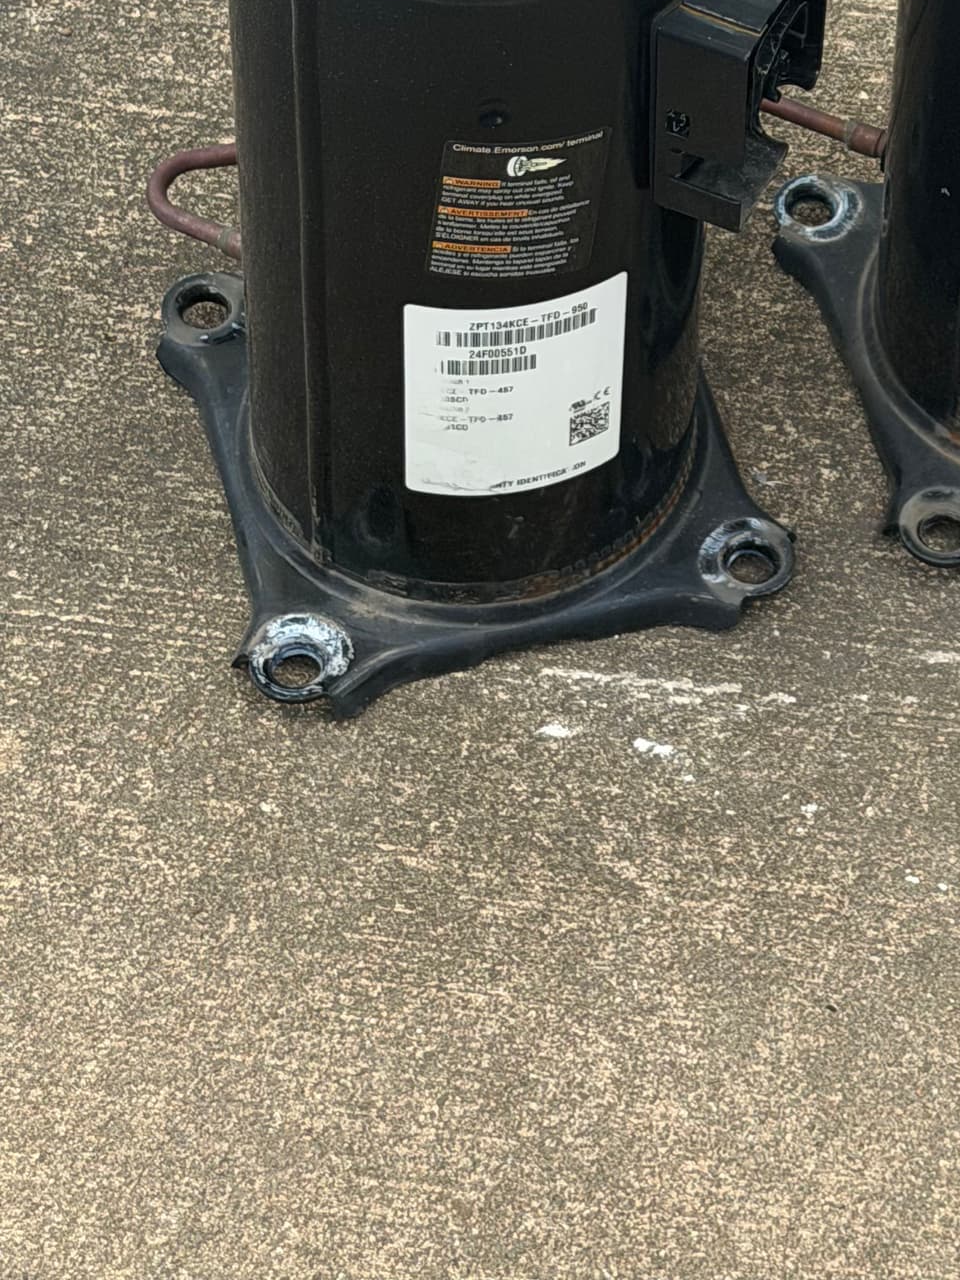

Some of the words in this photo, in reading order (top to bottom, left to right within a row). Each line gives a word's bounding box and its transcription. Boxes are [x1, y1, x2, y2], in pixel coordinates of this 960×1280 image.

[454, 178, 499, 188] WARNING
[450, 208, 527, 217] AVERTISSEMENT
[444, 243, 509, 252] ADVERTENCIA
[469, 346, 527, 359] 24F00551D
